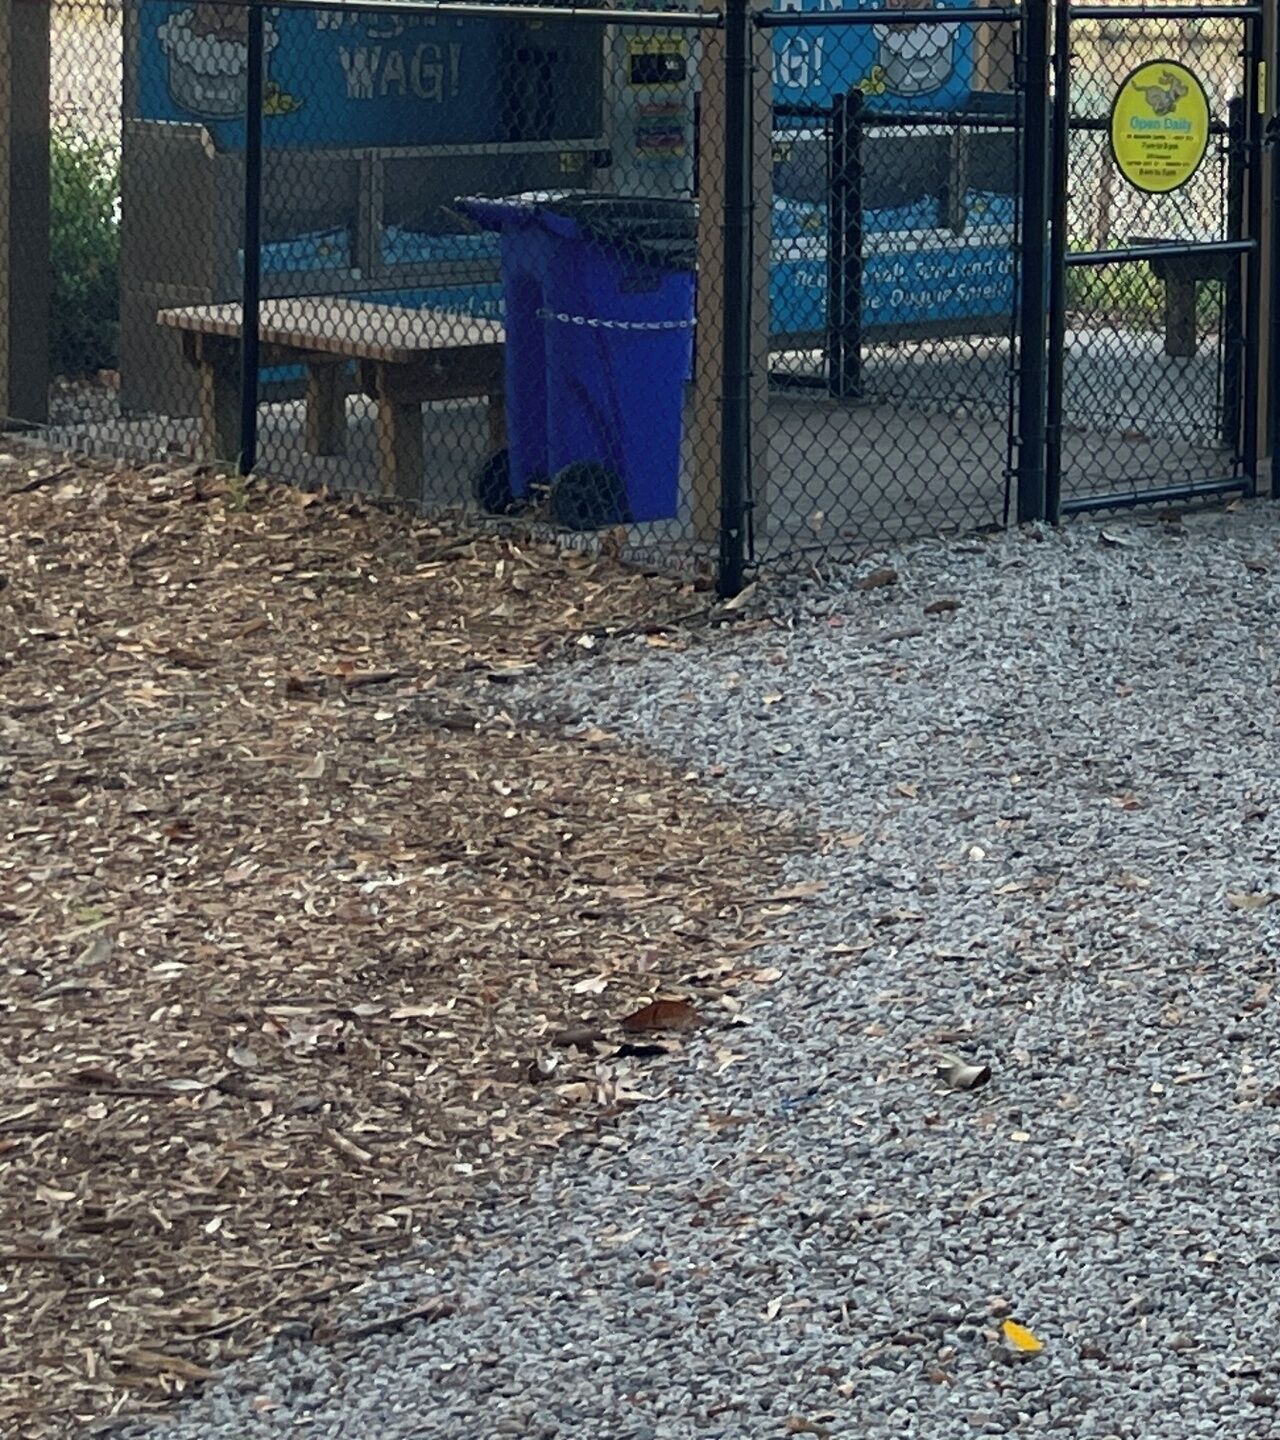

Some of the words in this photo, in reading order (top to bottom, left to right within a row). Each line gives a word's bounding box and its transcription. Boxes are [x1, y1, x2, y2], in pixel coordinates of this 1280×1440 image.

[338, 42, 462, 103] WAG!
[772, 36, 824, 89] G!
[1131, 116, 1160, 129] Open
[1164, 118, 1191, 133] Daily
